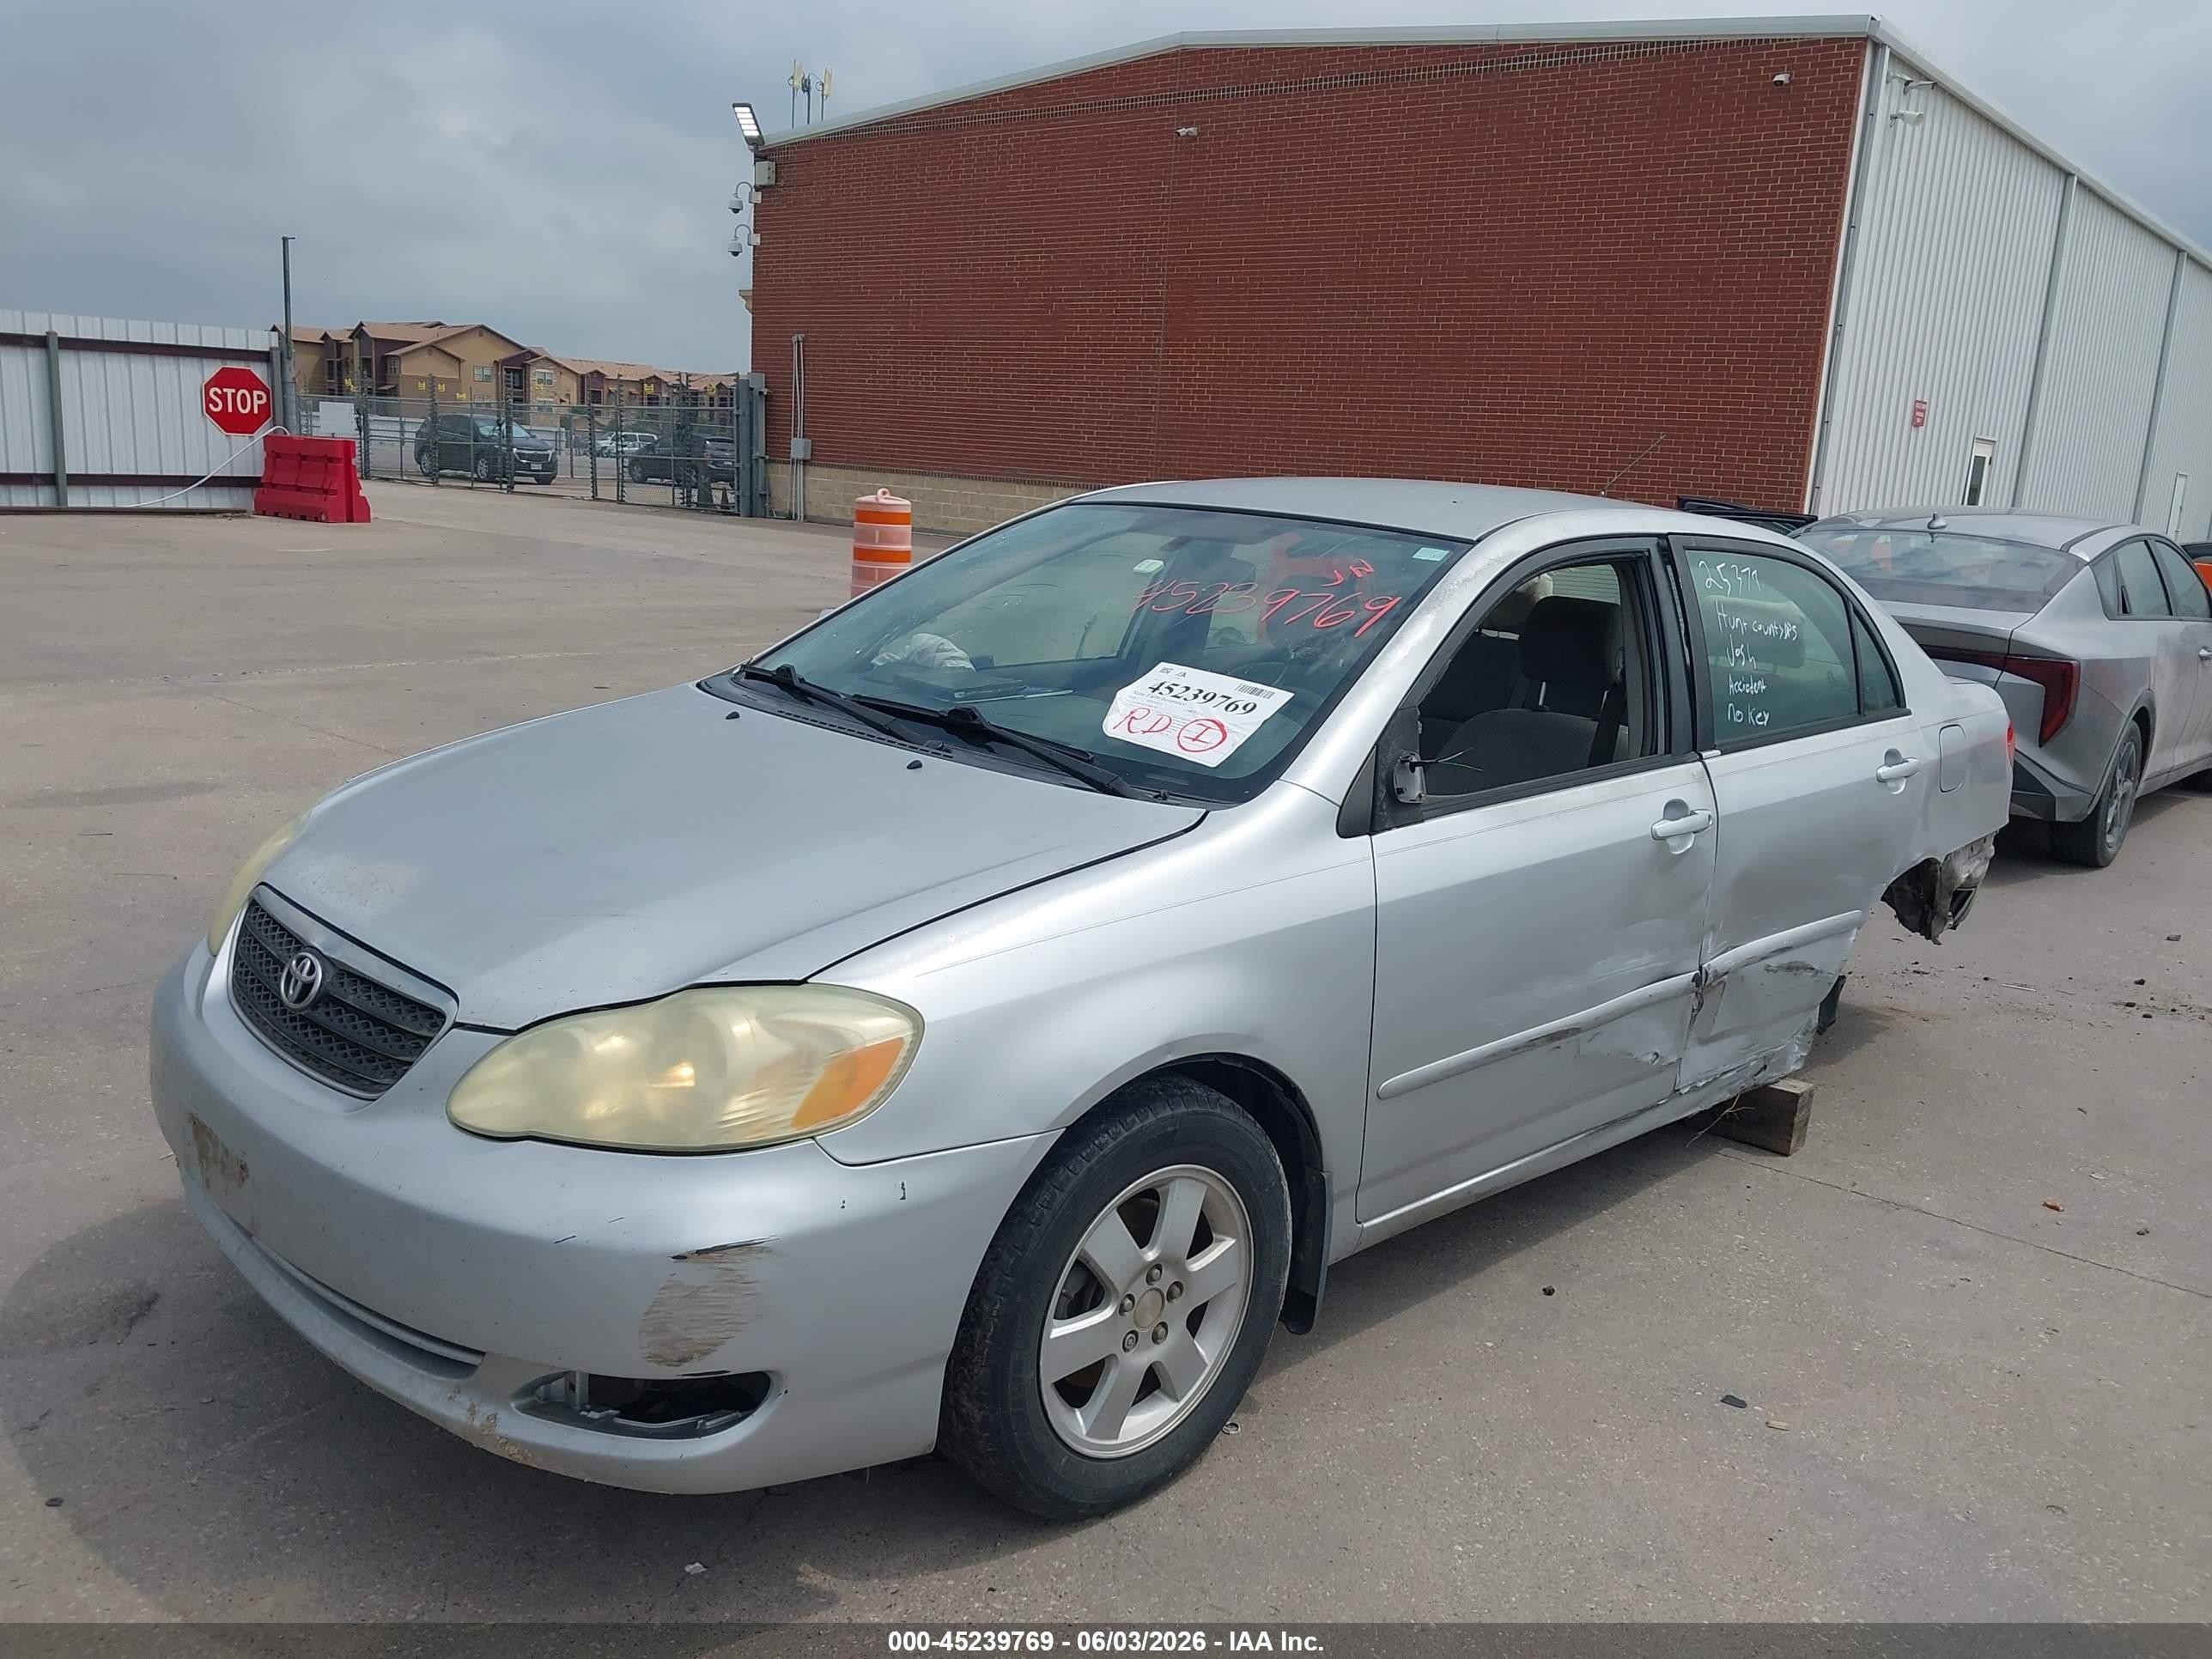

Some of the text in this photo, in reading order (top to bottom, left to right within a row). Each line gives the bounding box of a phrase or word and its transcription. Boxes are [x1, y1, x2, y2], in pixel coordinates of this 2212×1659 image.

[209, 387, 268, 415] STOP
[1133, 579, 1402, 638] 45239769
[1726, 634, 1757, 669] Josh
[1148, 681, 1257, 714] 45239769
[1113, 708, 1172, 734] RD
